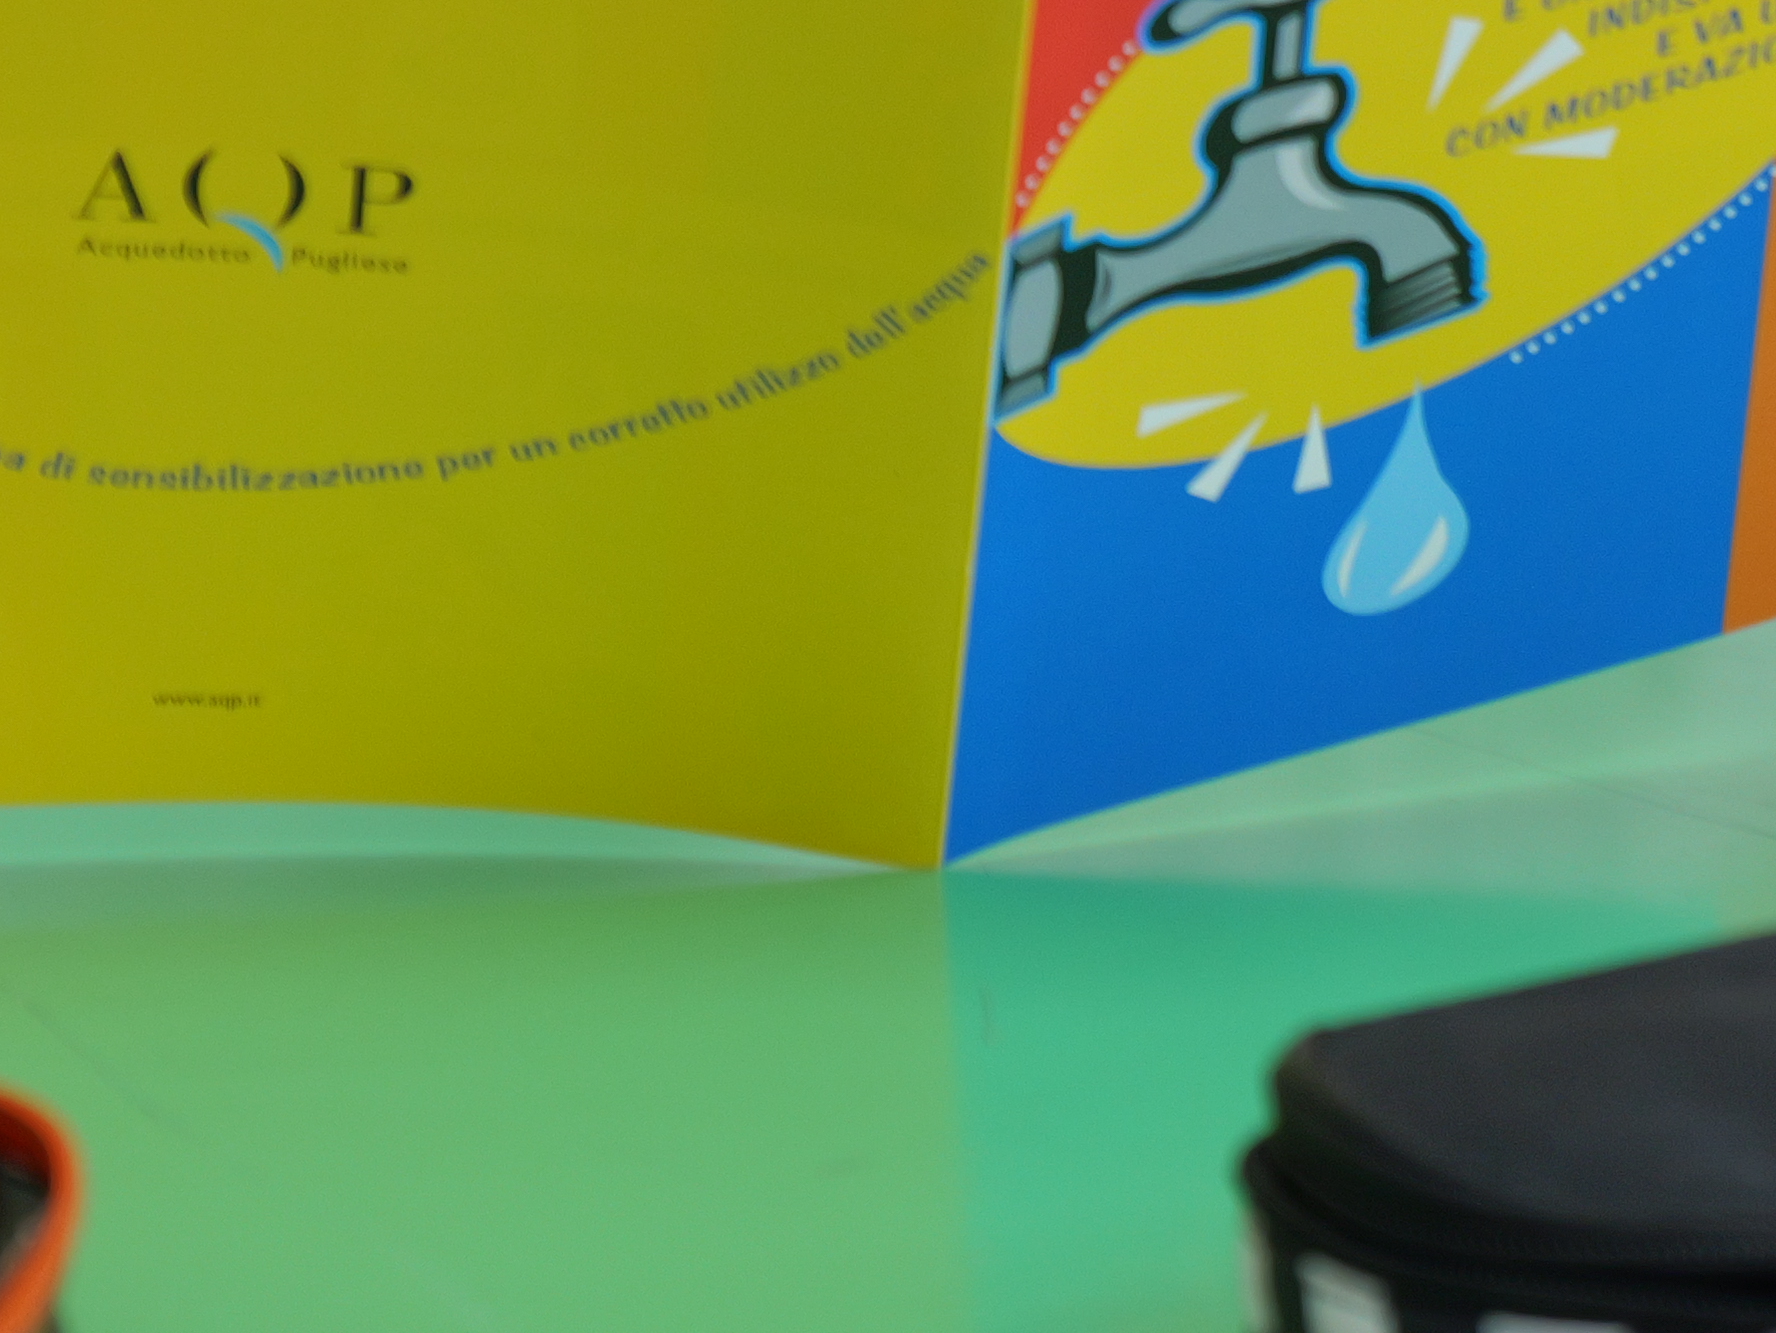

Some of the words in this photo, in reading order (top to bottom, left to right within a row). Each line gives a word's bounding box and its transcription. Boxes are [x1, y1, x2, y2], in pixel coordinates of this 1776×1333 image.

[1655, 28, 1672, 60] E
[1692, 7, 1746, 46] VA
[1444, 109, 1532, 160] CON
[71, 146, 416, 270] AQP
[76, 237, 252, 264] Acquedotto
[290, 246, 410, 275] Pugliese
[39, 451, 77, 483] di
[88, 458, 424, 494] sensibilizzazione
[435, 446, 495, 482] per
[509, 435, 558, 464] un
[567, 396, 711, 453] corretto
[716, 348, 844, 411] utilizzo
